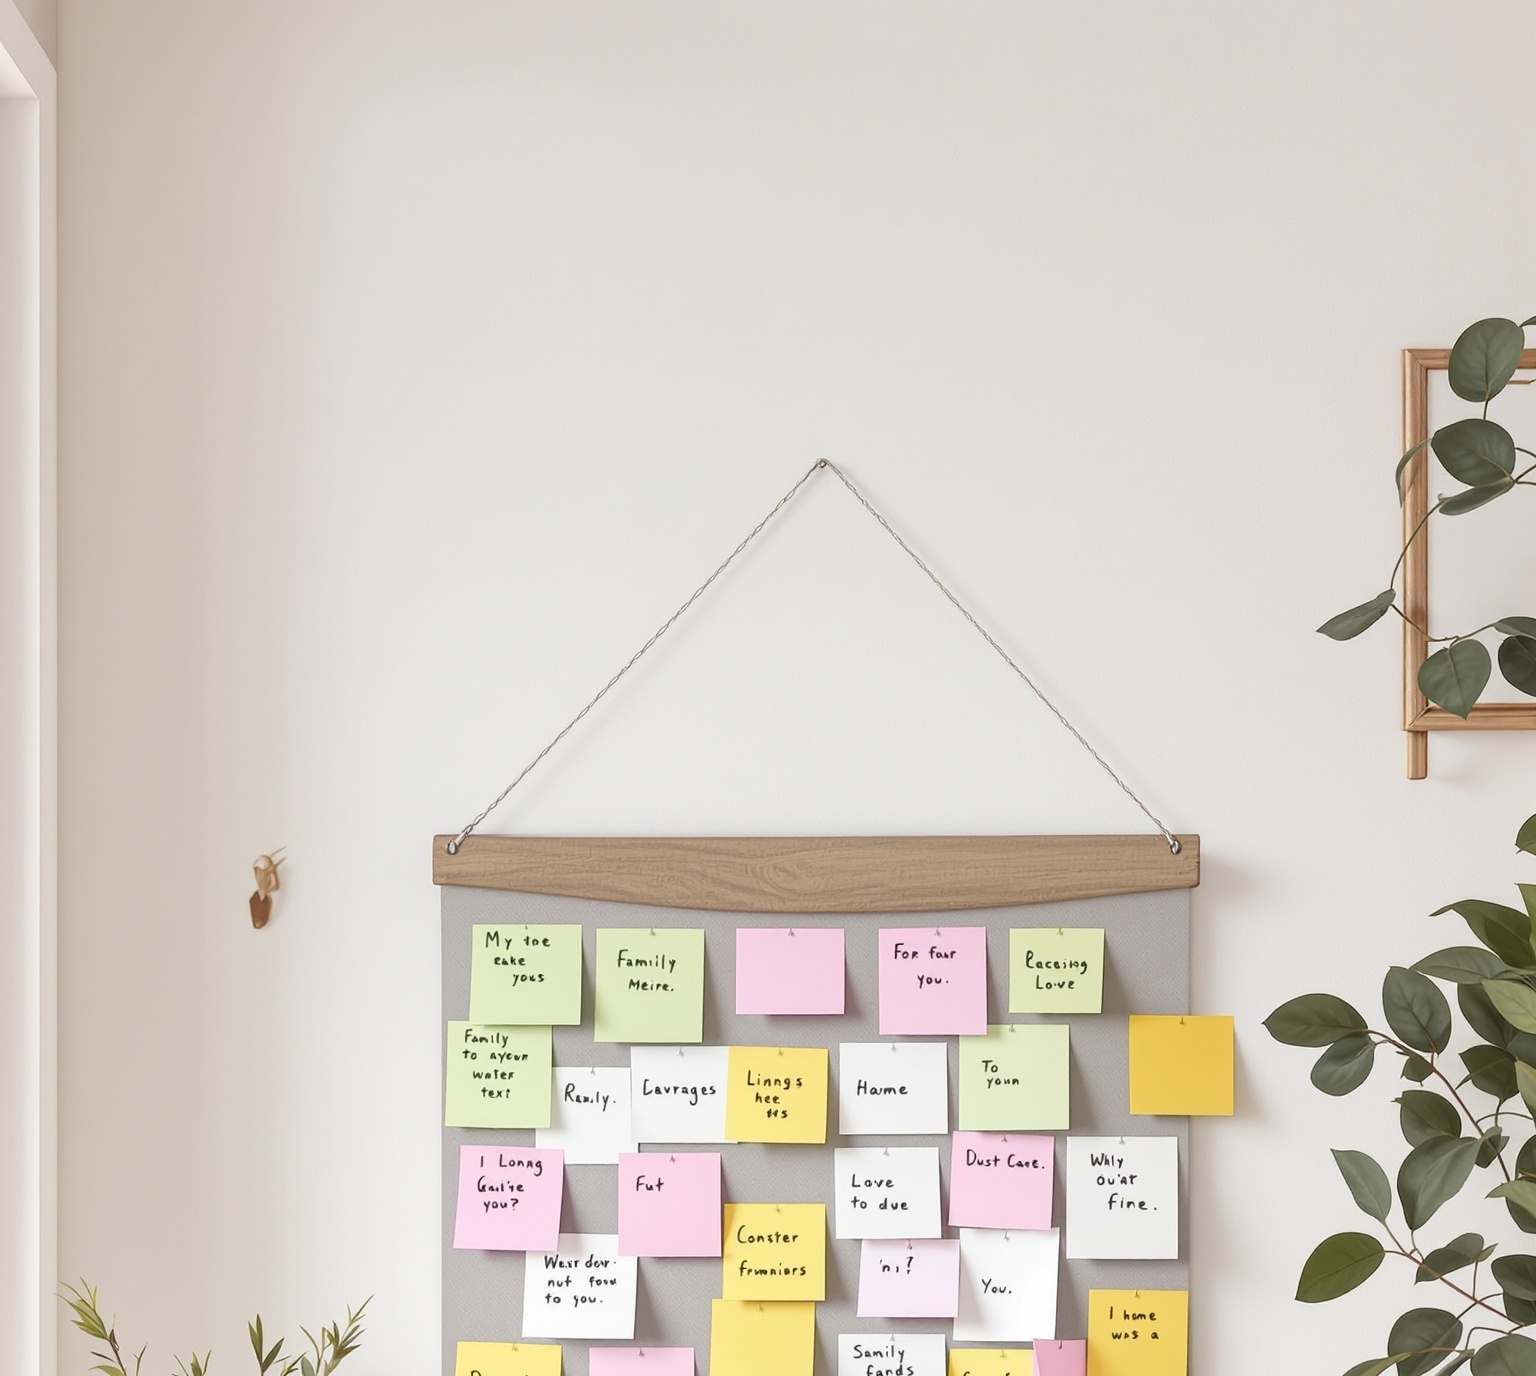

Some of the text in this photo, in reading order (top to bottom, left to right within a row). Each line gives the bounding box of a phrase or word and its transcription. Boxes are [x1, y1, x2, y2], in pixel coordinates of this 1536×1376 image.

[485, 930, 513, 951] My
[893, 942, 919, 960] For
[916, 974, 949, 990] you.
[461, 1048, 478, 1061] to
[981, 1059, 999, 1074] To
[966, 1148, 1001, 1168] Dust
[635, 1174, 665, 1192] Fut
[483, 1197, 520, 1214] you?
[850, 1196, 868, 1210] to
[1107, 1192, 1158, 1211] fine.
[547, 1274, 573, 1288] nut
[981, 1278, 1013, 1295] You.
[544, 1292, 562, 1304] to
[1150, 1331, 1160, 1340] a
